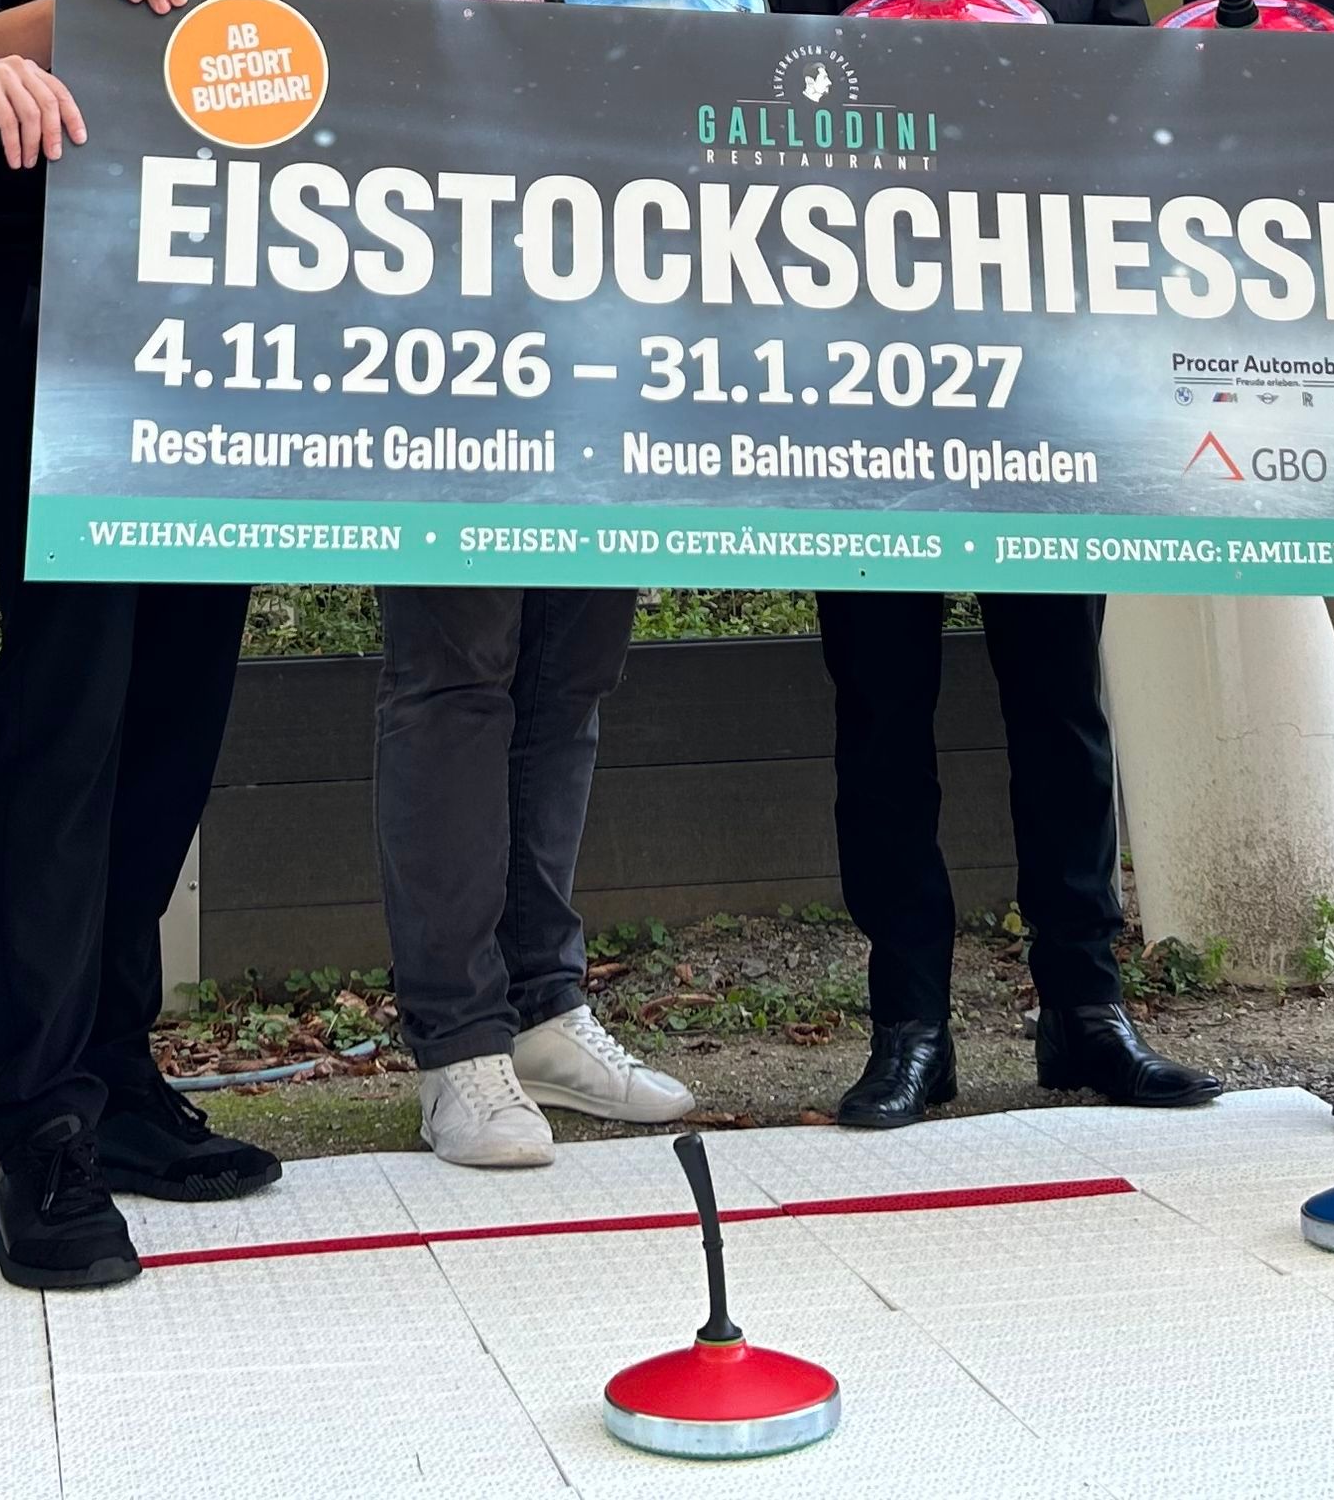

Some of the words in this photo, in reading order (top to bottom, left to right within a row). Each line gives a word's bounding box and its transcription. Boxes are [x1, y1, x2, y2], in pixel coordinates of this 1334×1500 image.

[226, 23, 260, 50] AB
[199, 47, 293, 83] SOFORT
[191, 74, 314, 113] BUCHBAR!
[698, 104, 938, 152] GALLODINI
[705, 149, 930, 172] RESTAURANT
[134, 317, 552, 399] 4.11.2026
[639, 334, 1024, 410] 31.1.2027
[1172, 352, 1240, 373] Procar
[1235, 377, 1266, 387] Freude
[131, 419, 374, 470] Restaurant
[383, 426, 556, 473] Gallodini
[623, 431, 722, 477] Neue
[730, 434, 935, 482] Bahnstadt
[943, 440, 1098, 490] Opladen
[1251, 447, 1328, 483] GBO
[88, 520, 402, 550] WEIHNACHTSFEIERN
[459, 526, 591, 555] SPEISEN-
[597, 529, 661, 555] UND
[665, 524, 943, 559] GETRÄNKESPECIALS
[994, 536, 1079, 562] JEDEN
[1085, 536, 1223, 564] SONNTAG:
